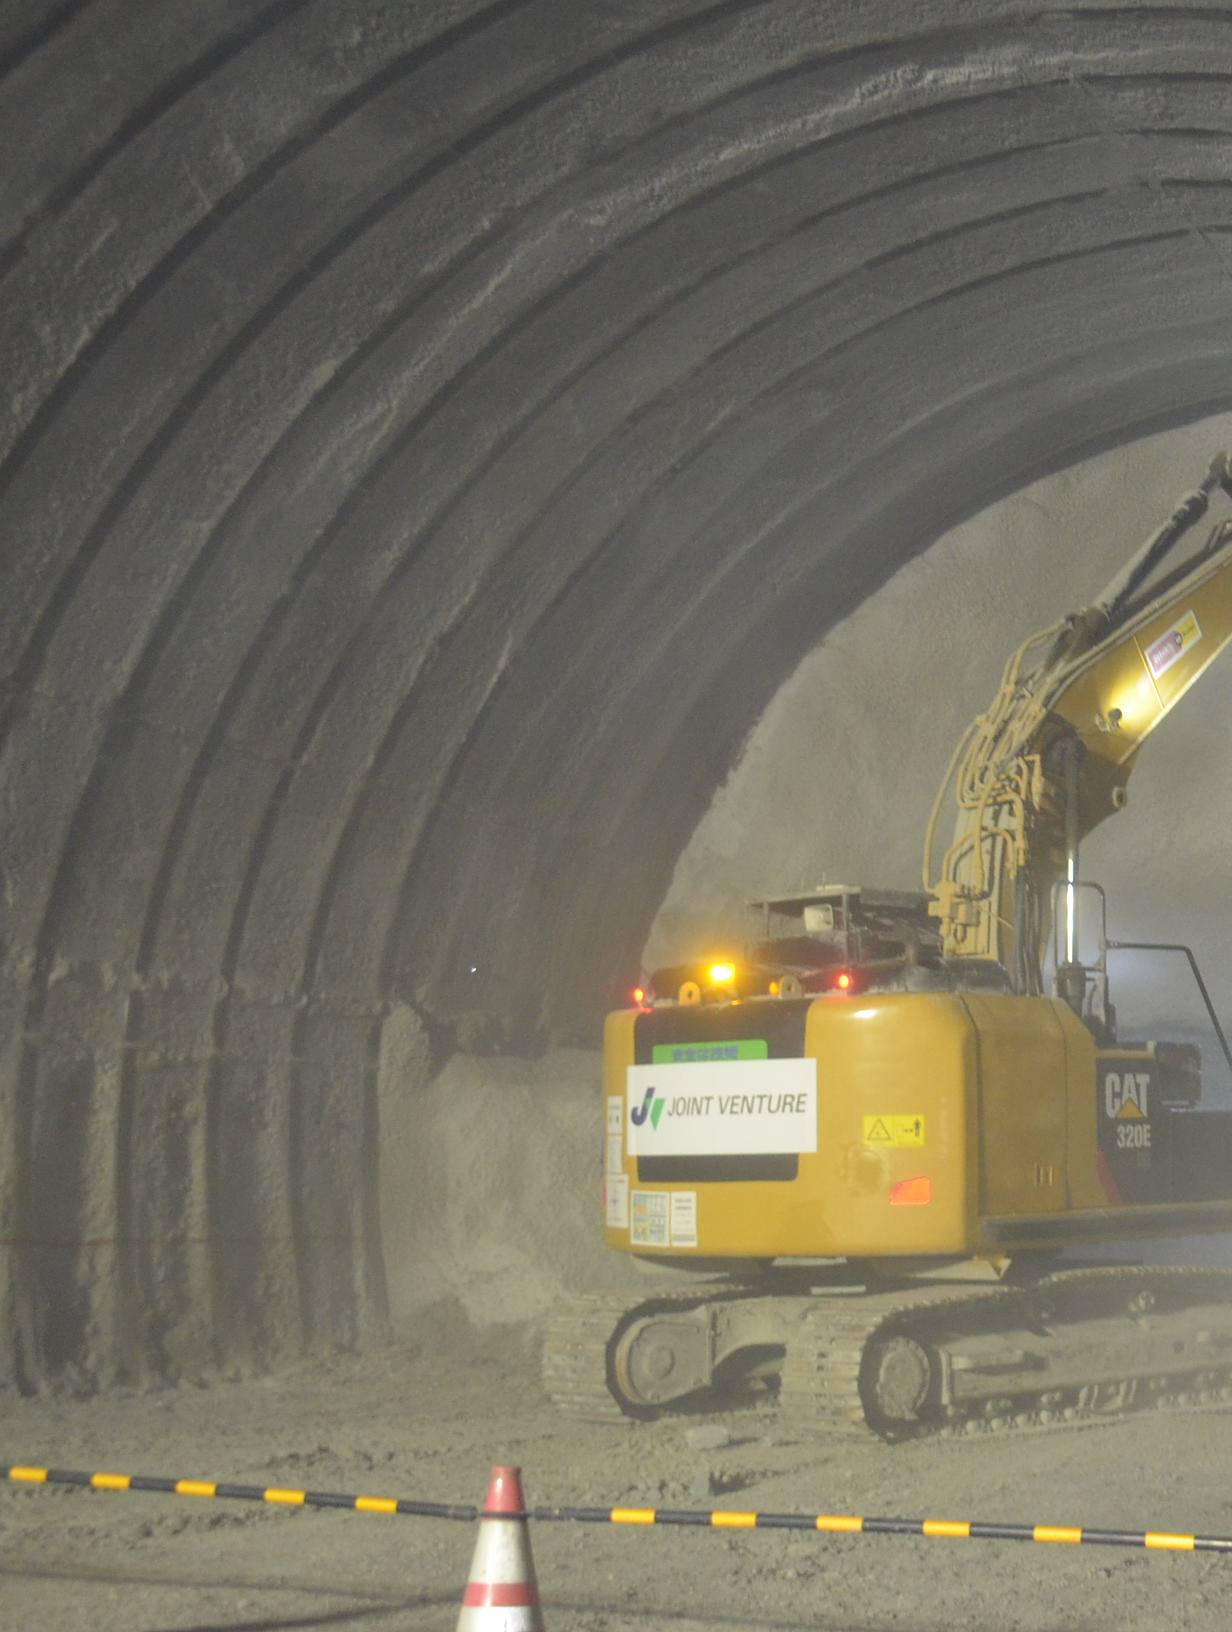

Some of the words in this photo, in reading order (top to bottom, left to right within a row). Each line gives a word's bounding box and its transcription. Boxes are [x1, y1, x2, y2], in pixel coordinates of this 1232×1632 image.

[668, 1096, 714, 1118] JOINT
[718, 1093, 808, 1117] VENTURE
[1105, 1072, 1150, 1120] CAT
[1117, 1124, 1151, 1149] 320E
